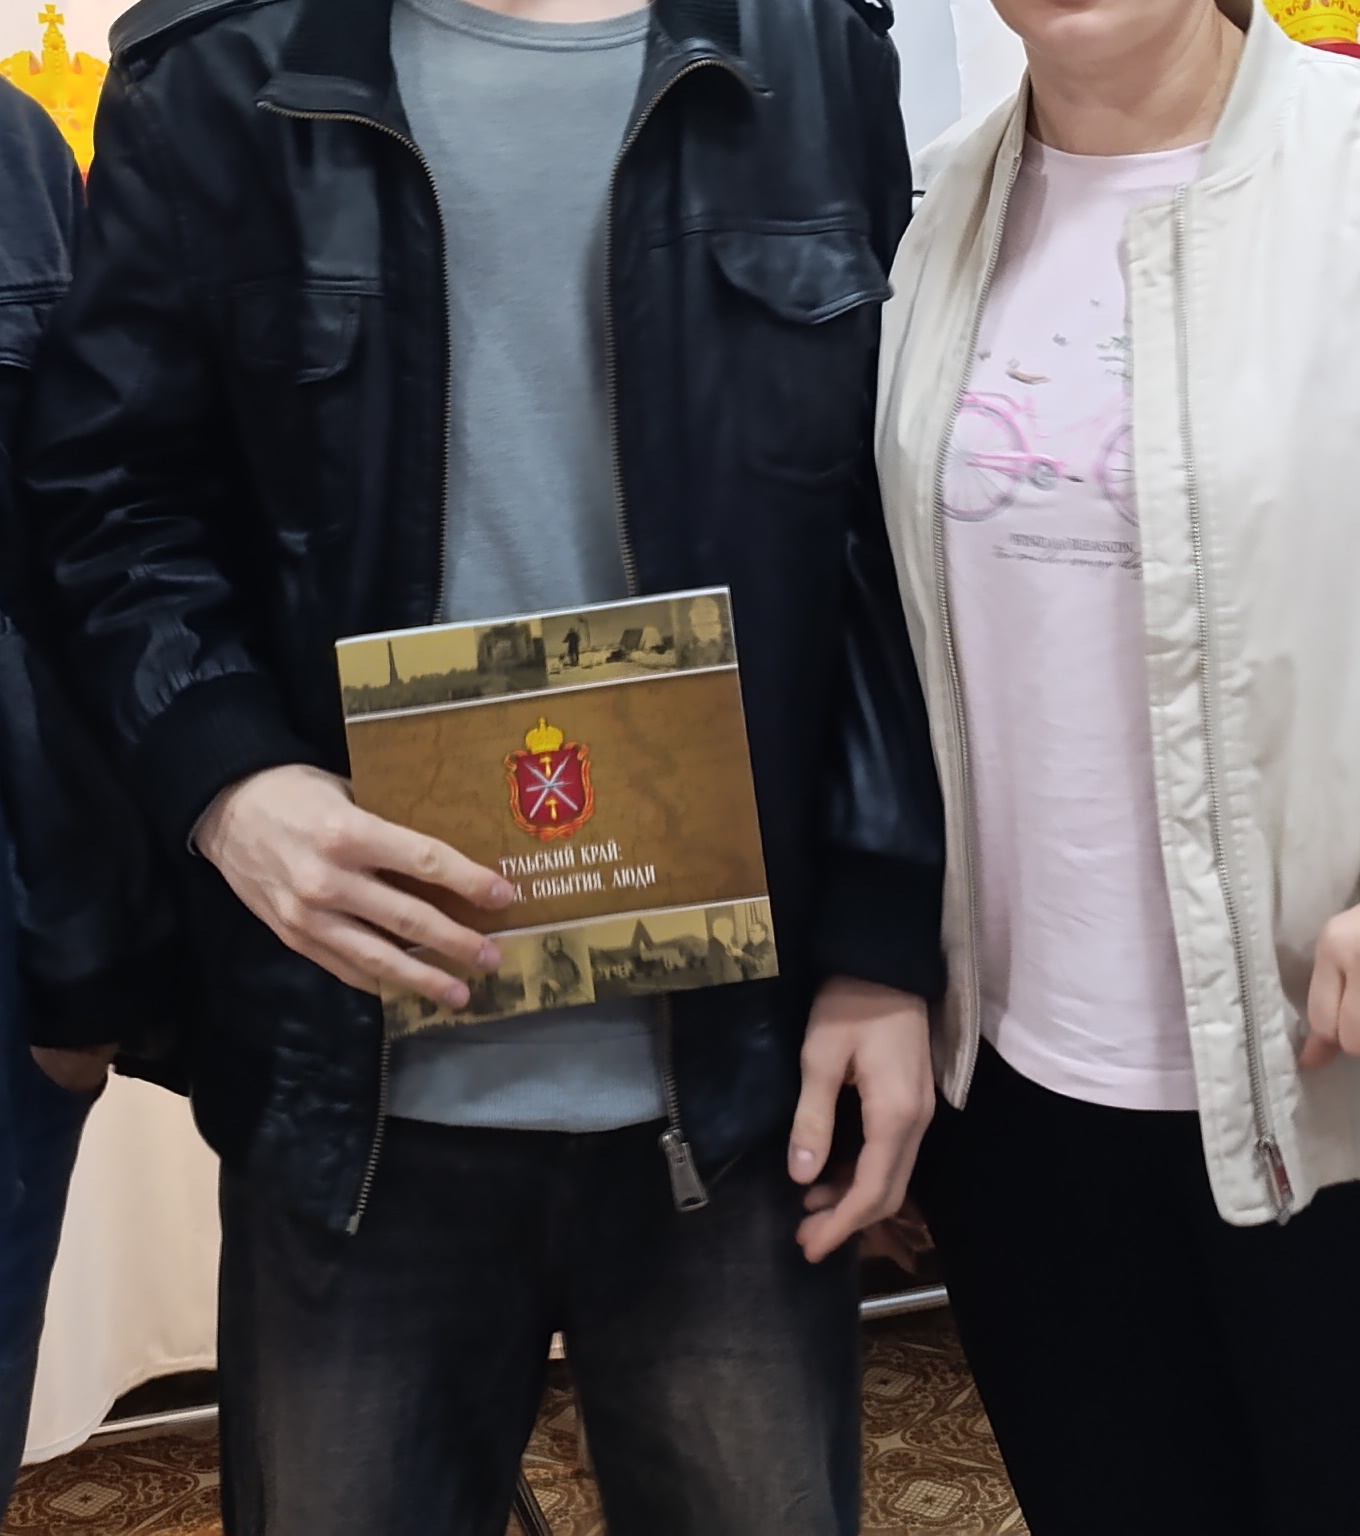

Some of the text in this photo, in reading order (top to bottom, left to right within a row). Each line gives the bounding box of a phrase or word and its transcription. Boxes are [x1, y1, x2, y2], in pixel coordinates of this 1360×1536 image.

[499, 839, 623, 876] ТУЛЬСКИЙ КРАЙ:
[532, 864, 656, 900] СОБЫТИЯ, ЛЮДИ
